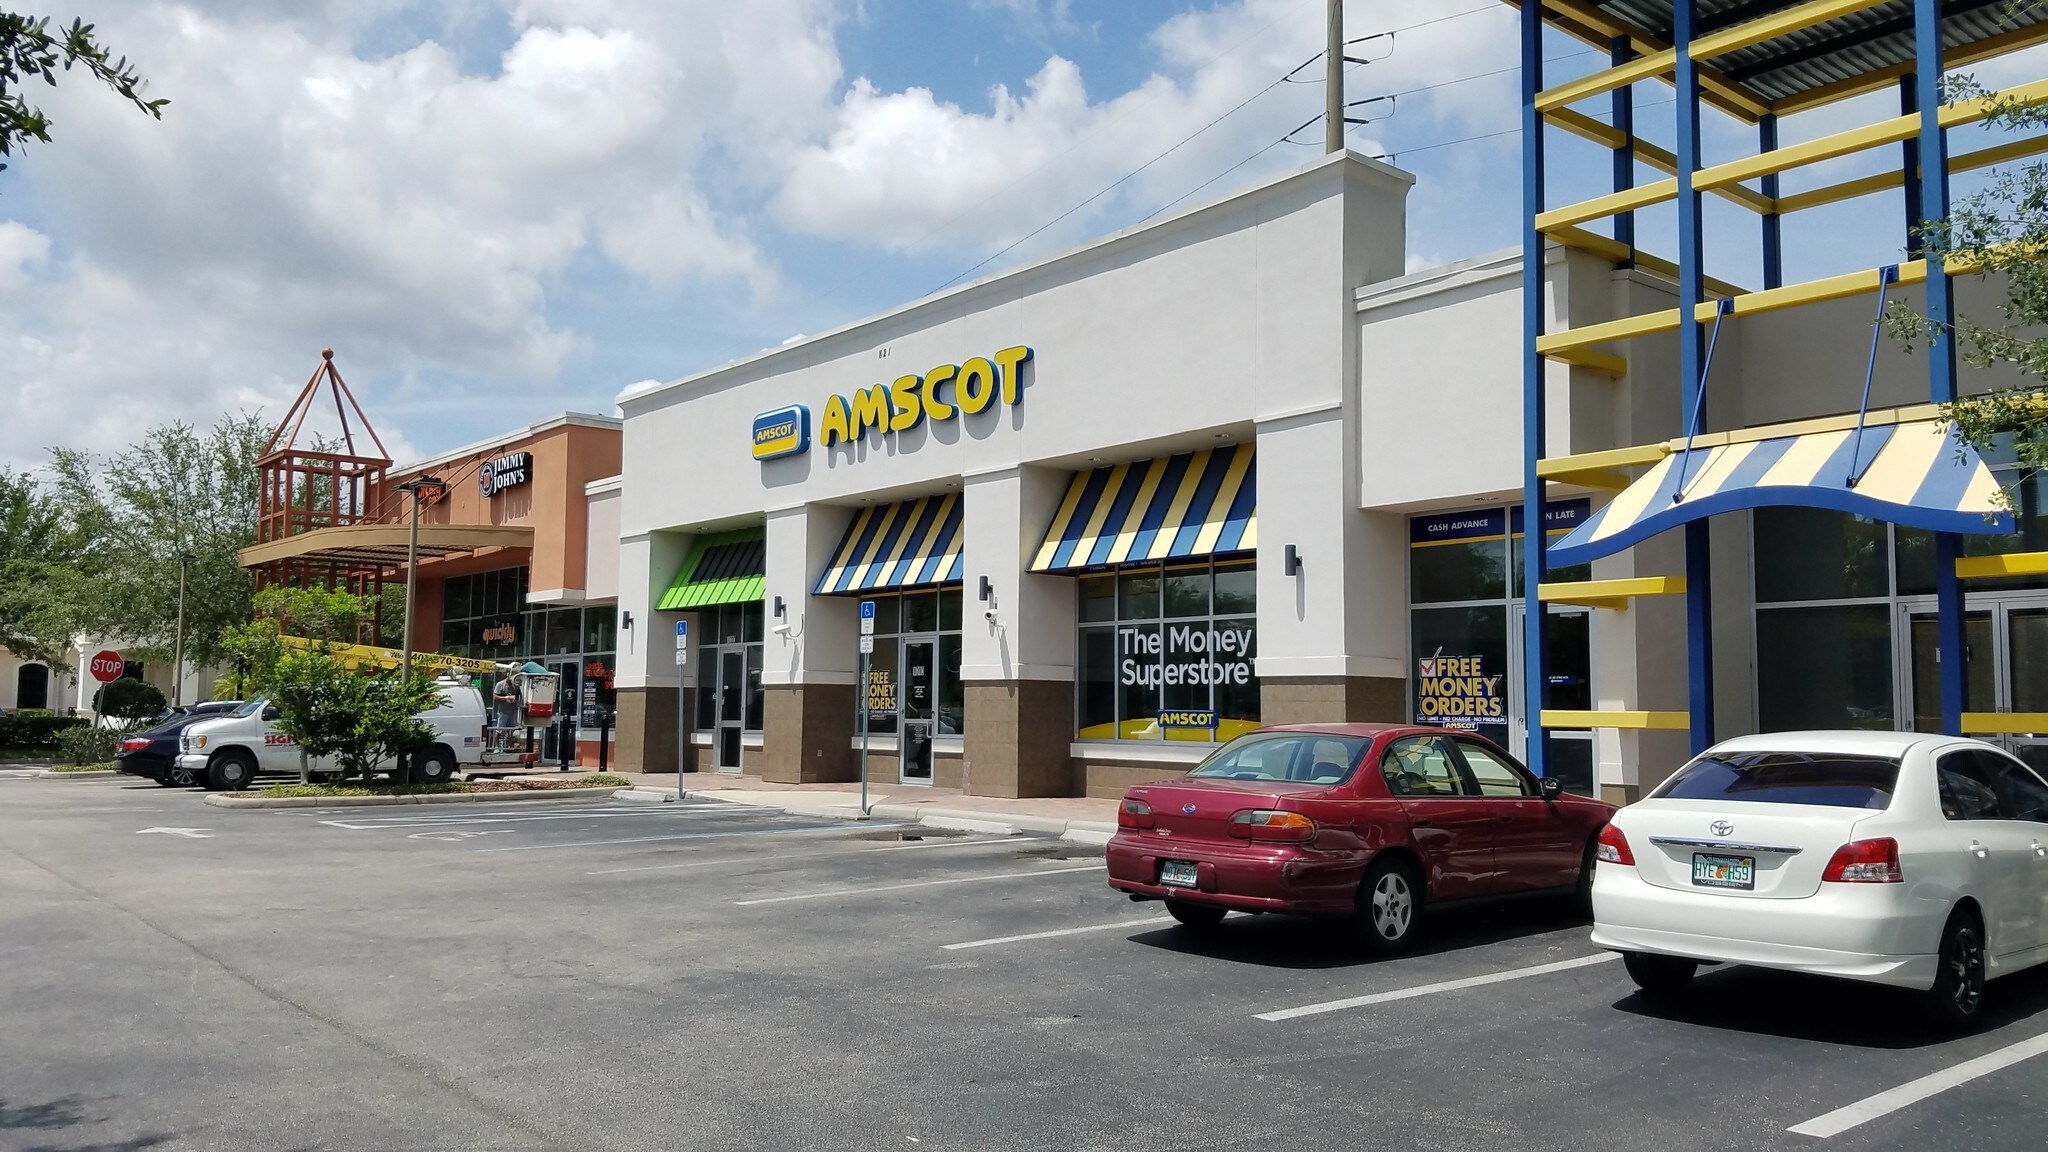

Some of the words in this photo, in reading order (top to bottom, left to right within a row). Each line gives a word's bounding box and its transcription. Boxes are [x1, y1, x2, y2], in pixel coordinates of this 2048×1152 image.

[820, 345, 1032, 447] AMSCOT
[757, 423, 793, 442] AMSCOT
[494, 452, 525, 476] JIMMY
[493, 469, 525, 493] JOHN'S
[1555, 510, 1575, 520] LATE
[1427, 523, 1449, 532] CASH
[1451, 519, 1489, 530] ADVANCE
[1119, 628, 1161, 655] The
[1169, 626, 1252, 657] Money
[92, 659, 122, 673] STOP
[411, 653, 480, 669] 4070-3205
[1437, 658, 1481, 677] FREE
[869, 672, 889, 684] FREE
[1421, 677, 1498, 697] MONEY
[1421, 697, 1501, 716] ORDERS
[1159, 712, 1214, 725] AMSCOT
[1695, 862, 1715, 878] HYE
[1728, 865, 1749, 881] H59
